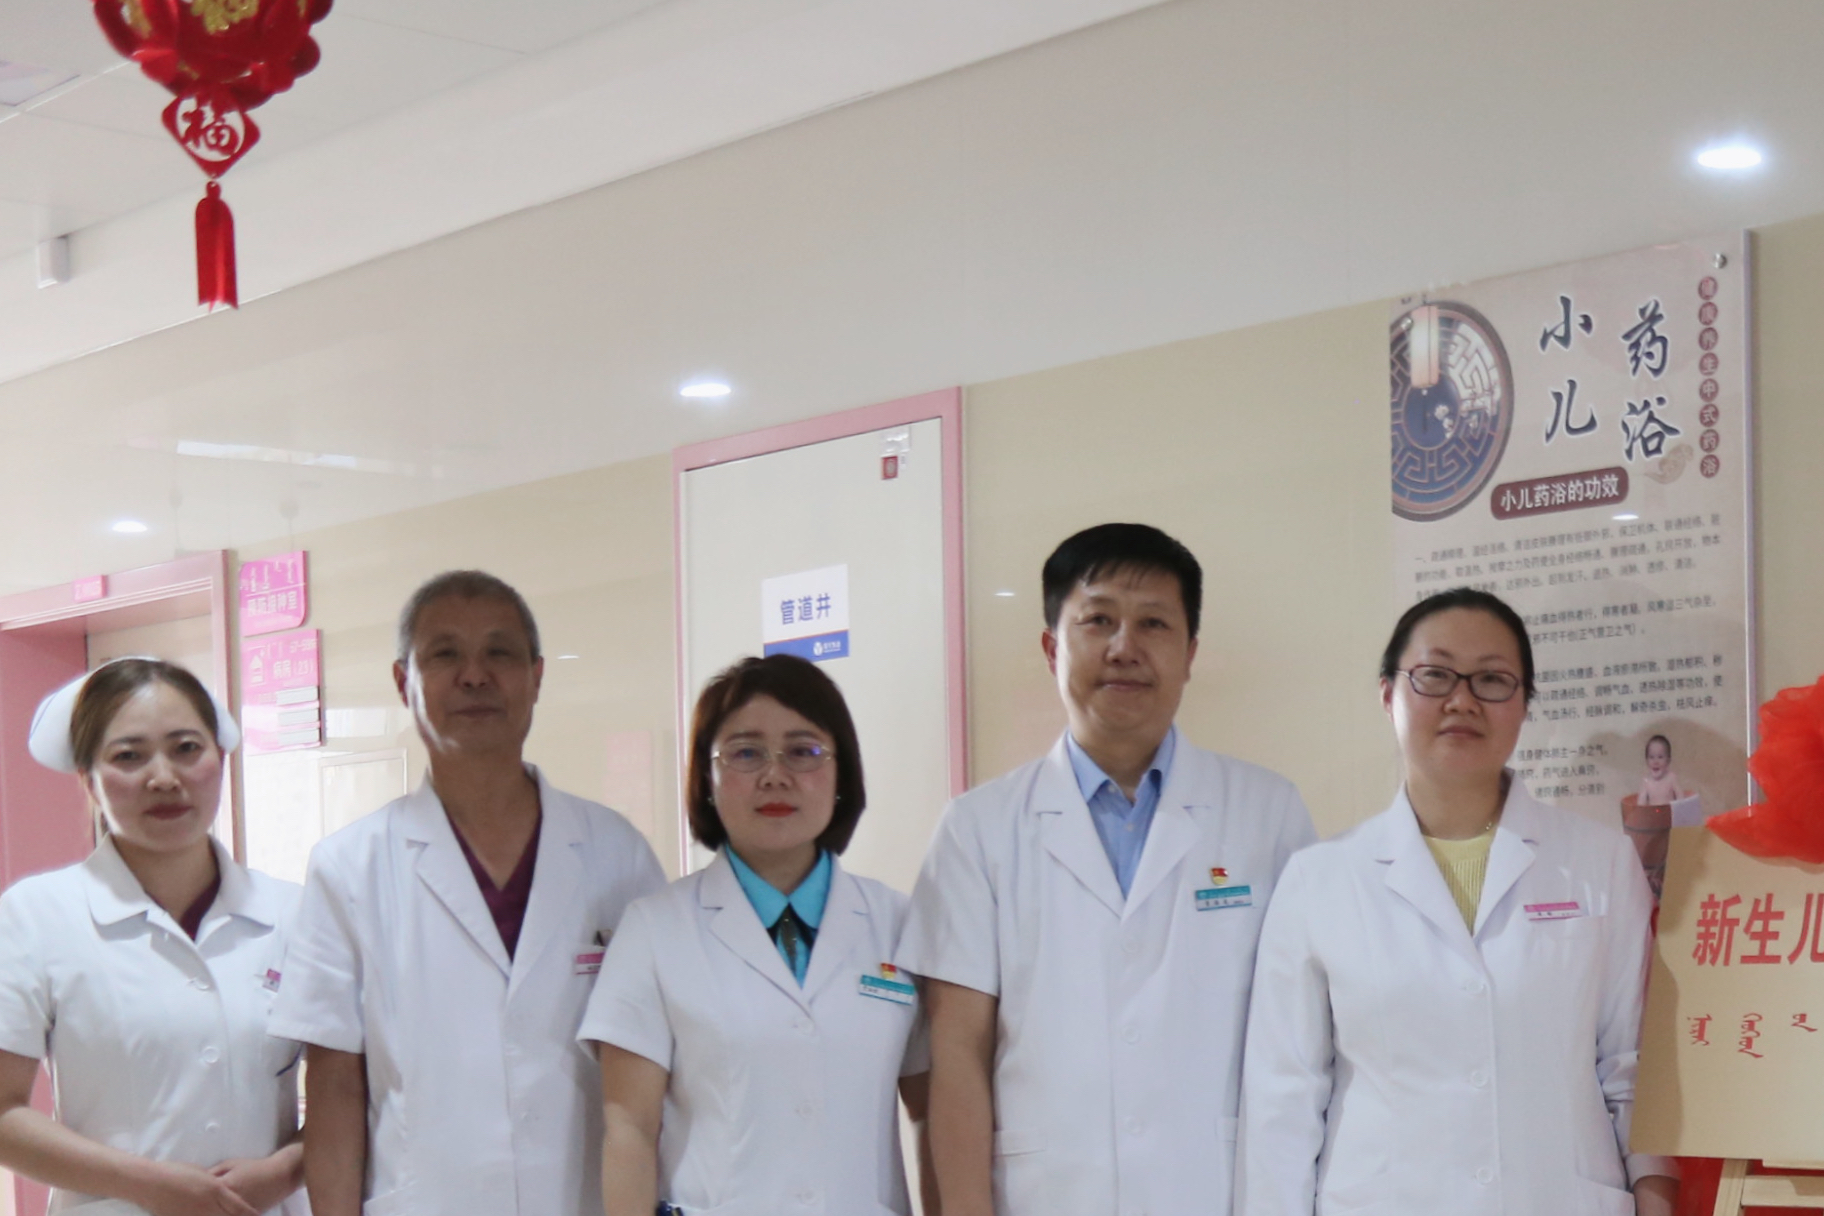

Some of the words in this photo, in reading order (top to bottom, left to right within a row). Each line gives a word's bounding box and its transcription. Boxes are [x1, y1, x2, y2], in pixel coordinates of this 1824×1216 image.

[1500, 474, 1620, 513] 小儿药浴的功效
[780, 592, 831, 626] 管道井
